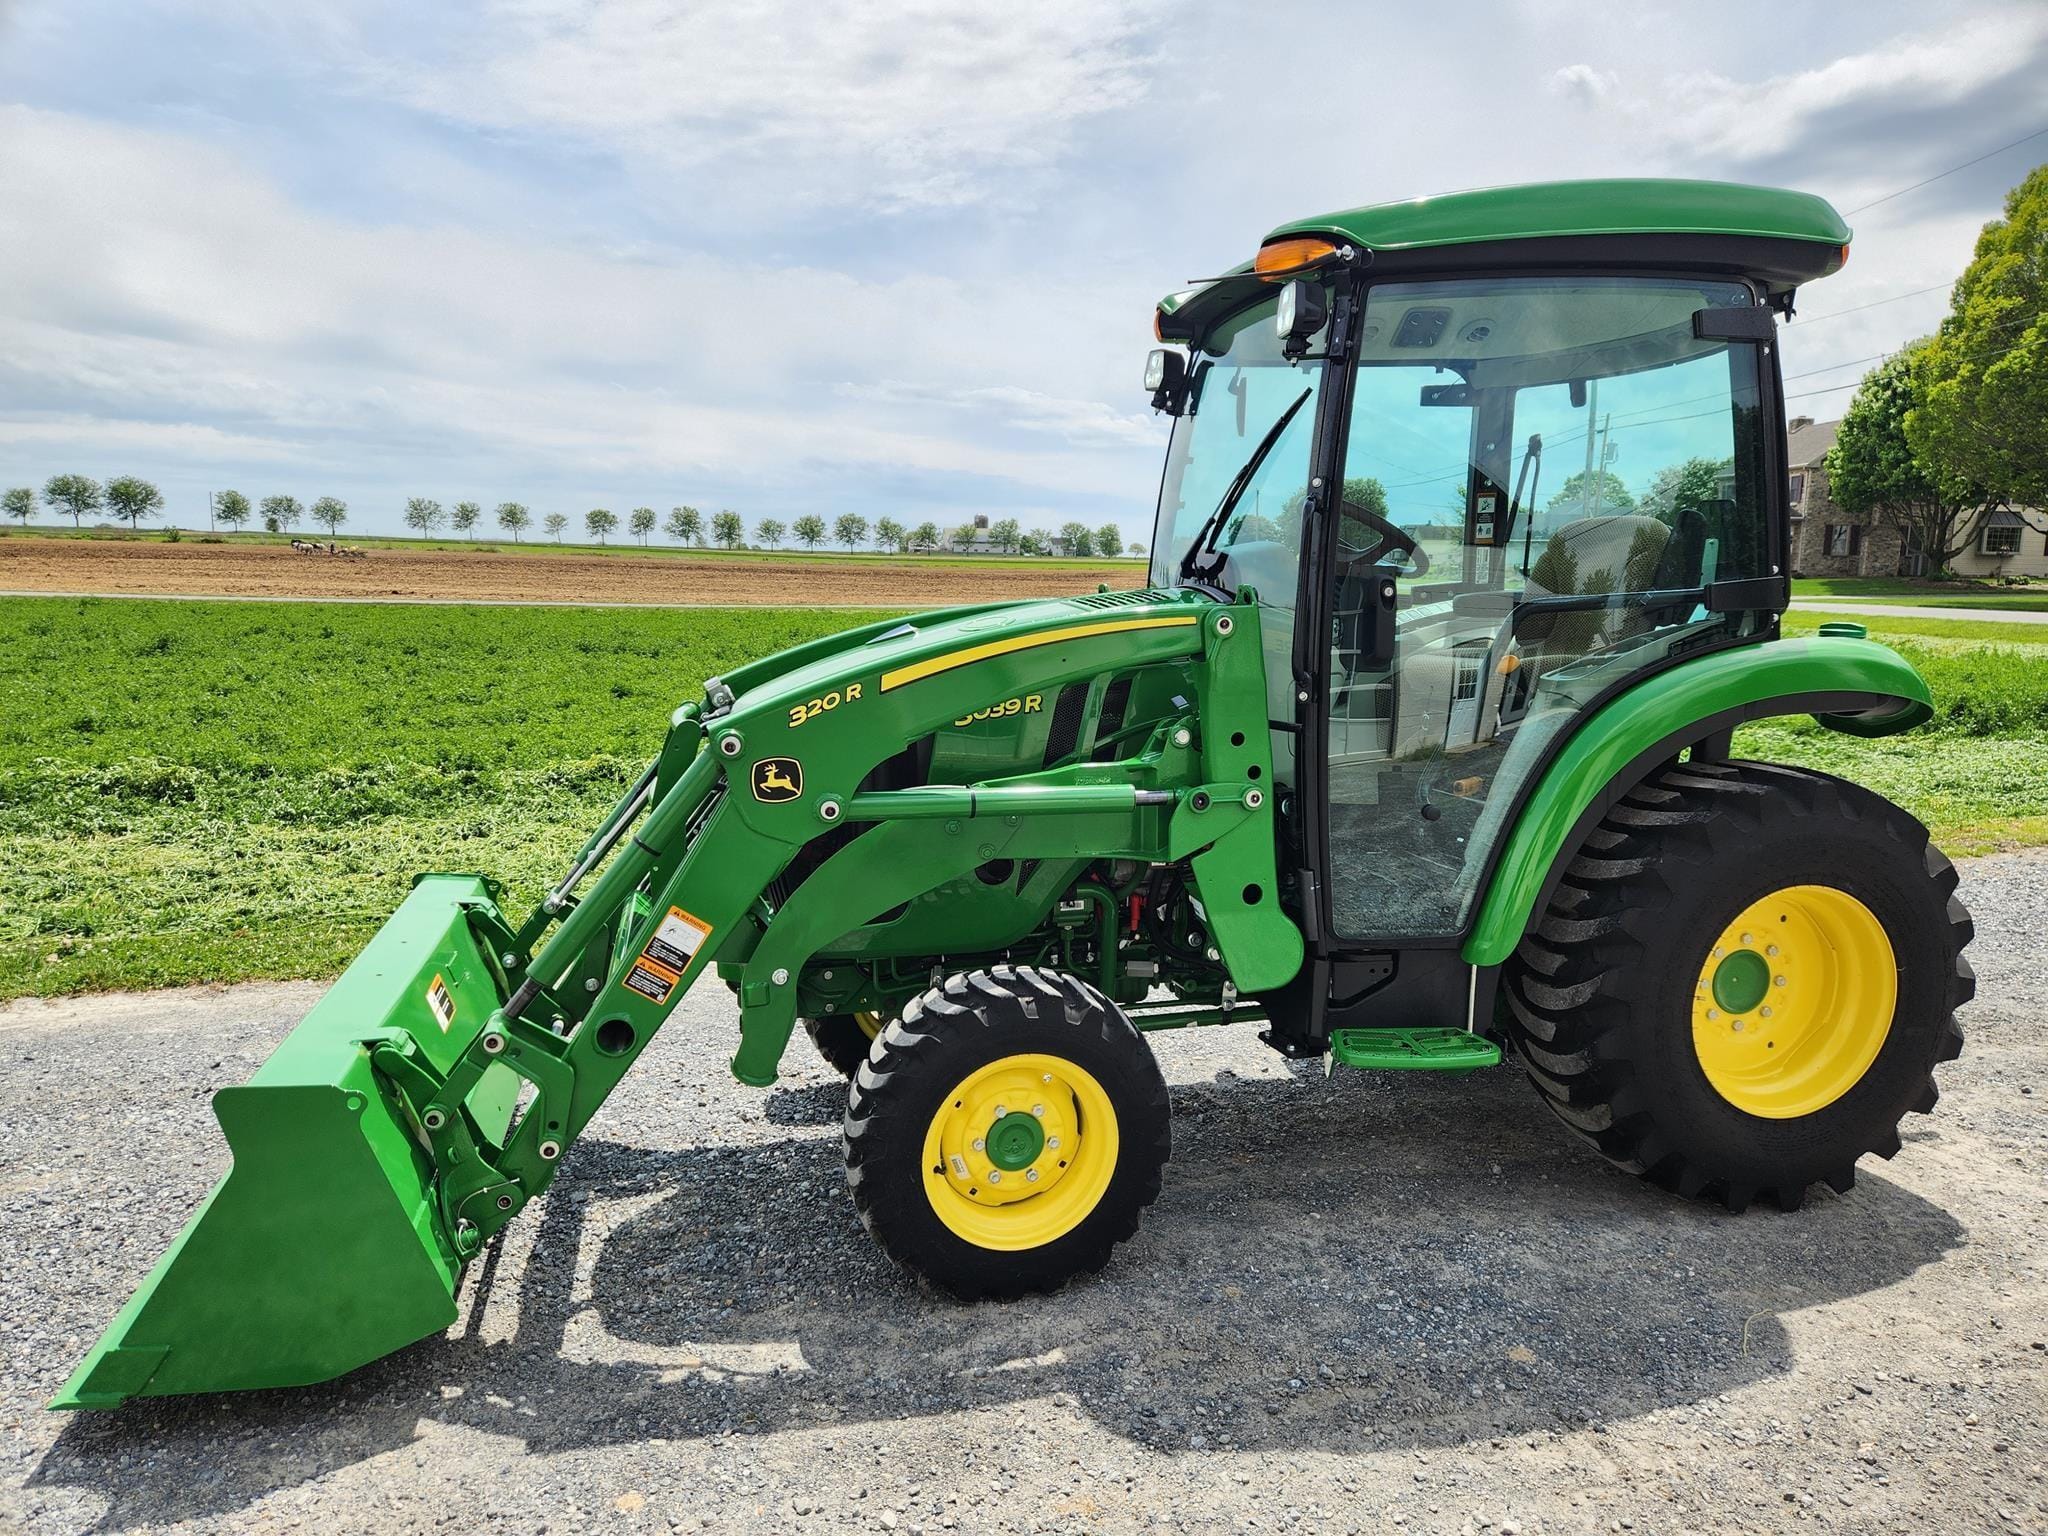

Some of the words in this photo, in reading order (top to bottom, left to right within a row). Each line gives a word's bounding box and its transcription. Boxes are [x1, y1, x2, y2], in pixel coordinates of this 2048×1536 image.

[788, 692, 841, 728] 320
[845, 682, 863, 703] R
[1024, 694, 1042, 713] R
